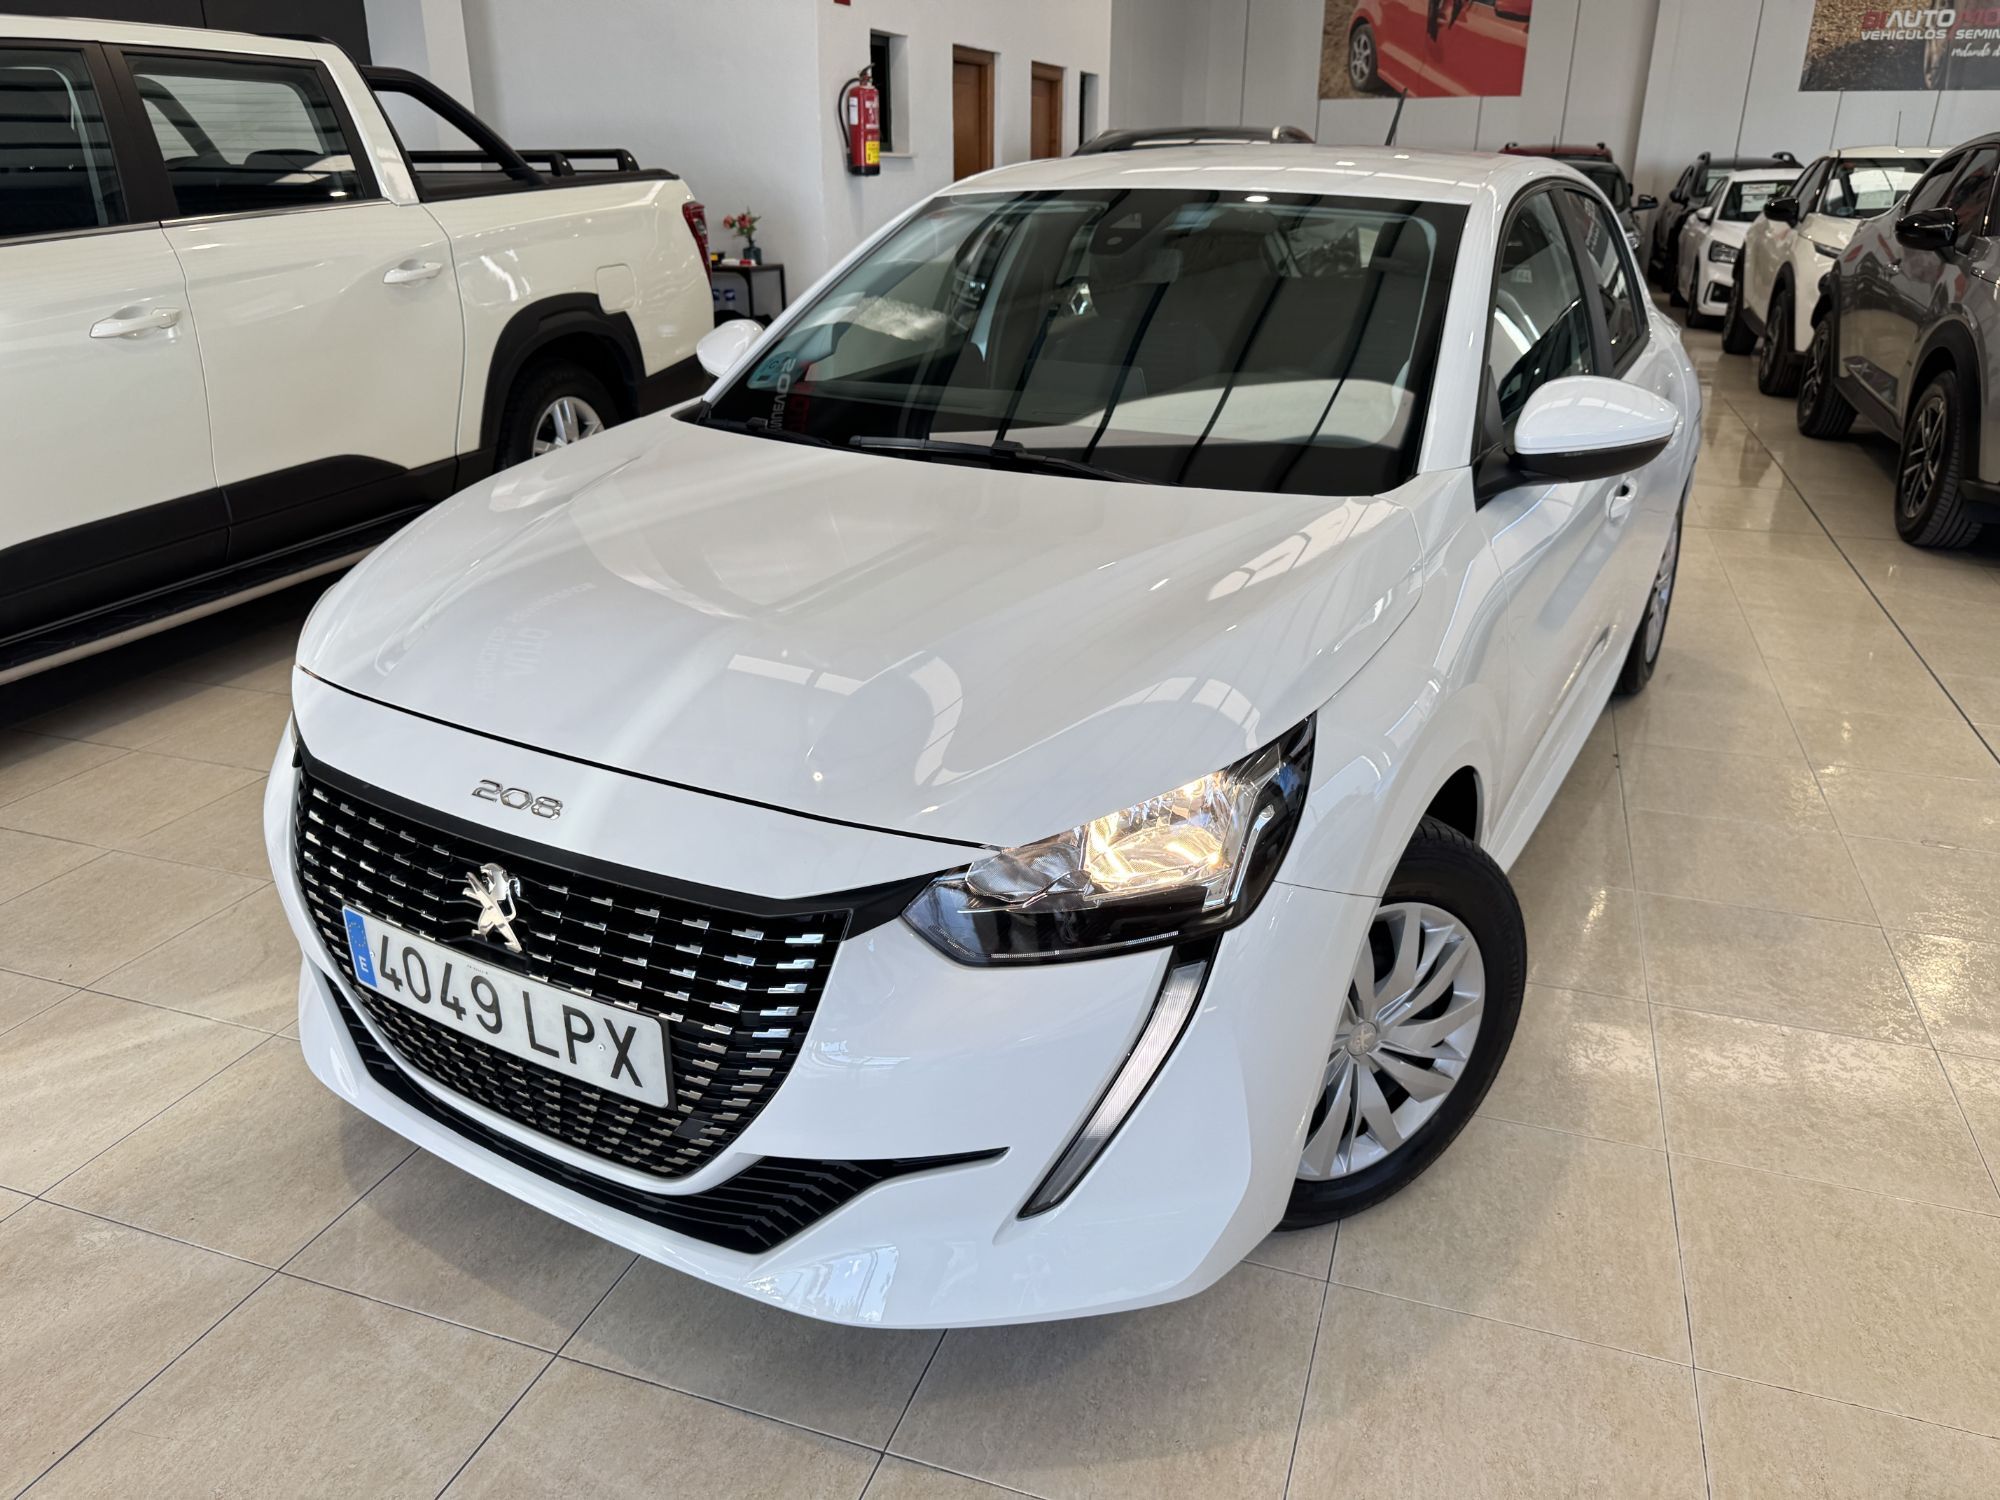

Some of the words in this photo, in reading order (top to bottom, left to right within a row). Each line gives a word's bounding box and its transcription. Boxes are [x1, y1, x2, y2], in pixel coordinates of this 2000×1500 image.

[1861, 29, 1947, 40] VEHICULOS
[471, 778, 564, 820] 208
[358, 955, 369, 973] E
[379, 934, 503, 1035] 4049
[522, 990, 643, 1088] LPX
